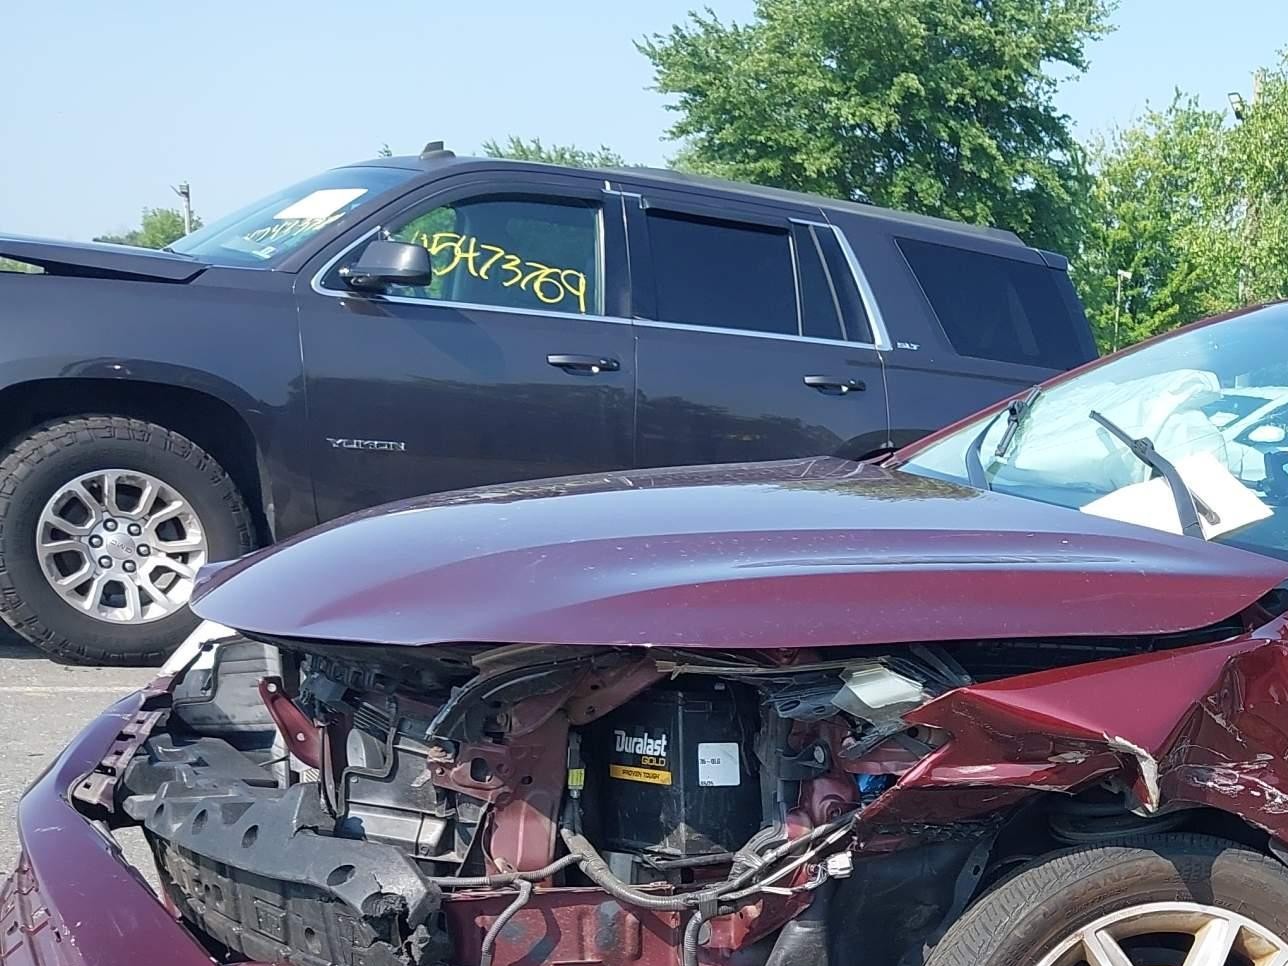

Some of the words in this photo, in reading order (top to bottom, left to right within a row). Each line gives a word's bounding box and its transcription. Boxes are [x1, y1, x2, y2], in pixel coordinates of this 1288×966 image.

[326, 437, 406, 451] YUKON
[614, 730, 667, 757] Duralast
[641, 755, 666, 767] GOLD
[622, 769, 642, 778] PROVEN
[643, 771, 660, 780] TOUGH
